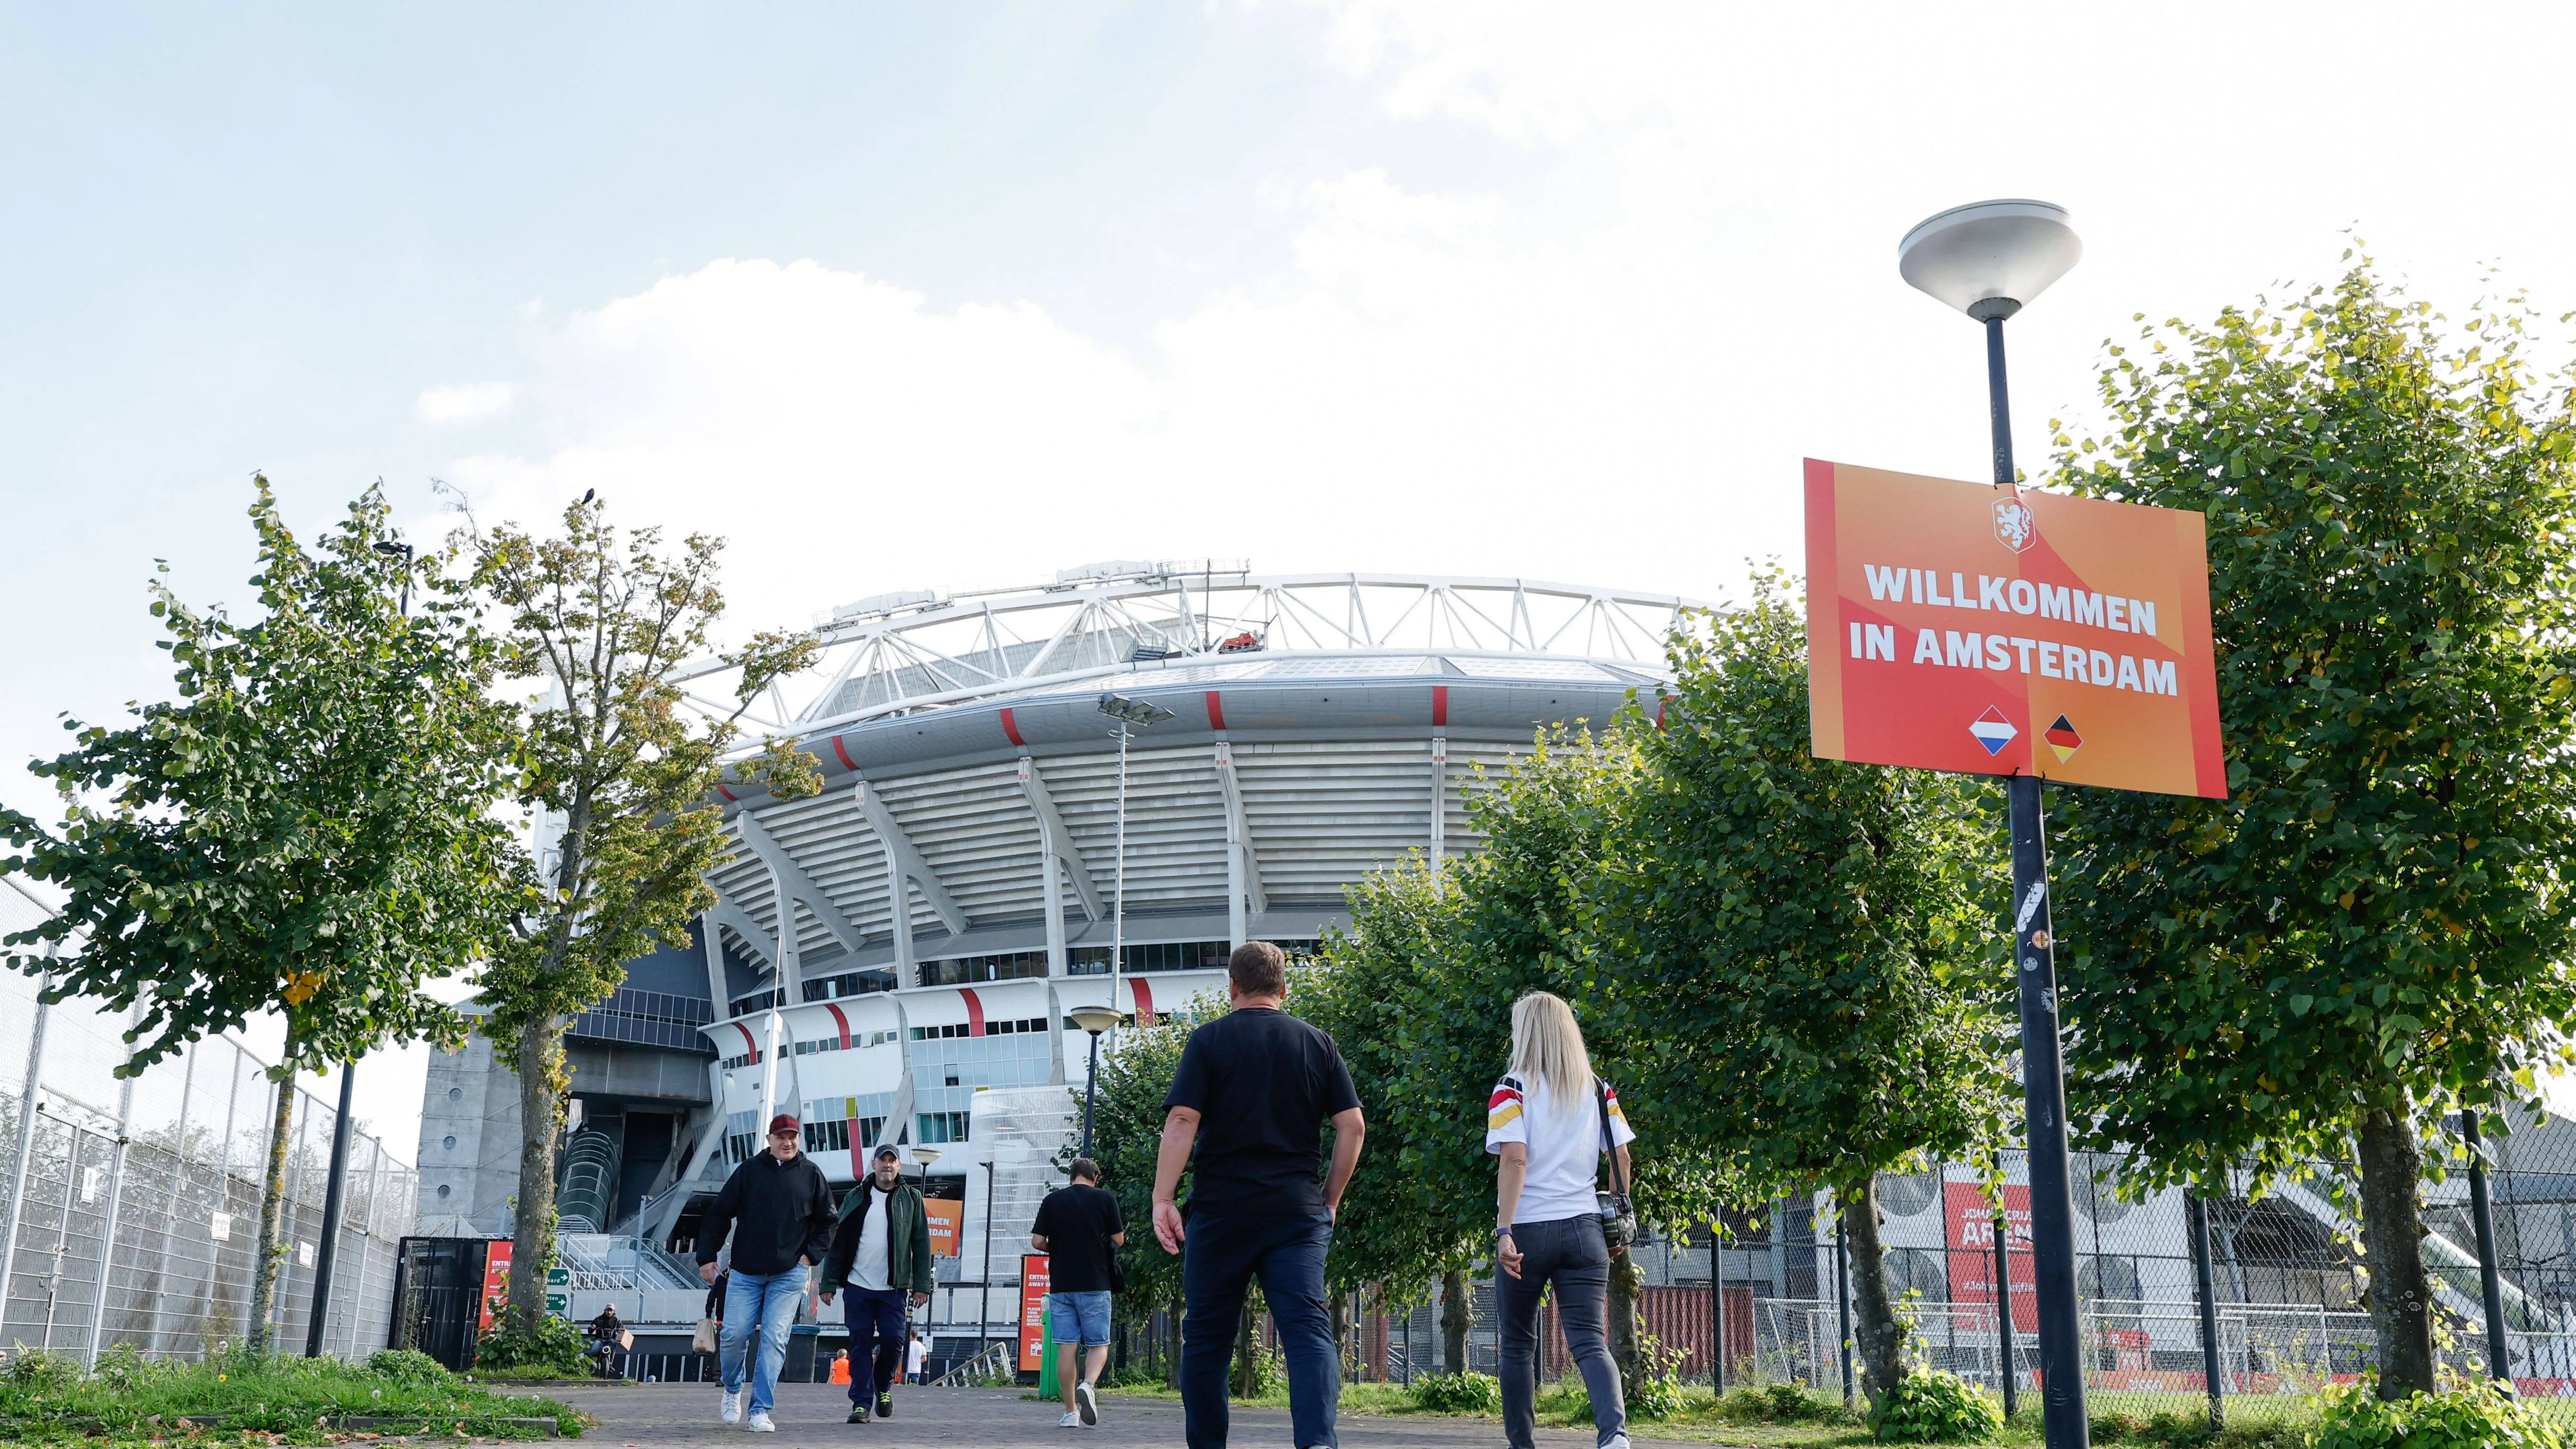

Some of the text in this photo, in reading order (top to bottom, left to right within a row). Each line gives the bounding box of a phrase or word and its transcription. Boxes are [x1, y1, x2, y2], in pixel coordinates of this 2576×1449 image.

[1864, 564, 2156, 637] WILLKOMMEN
[1850, 622, 2178, 696] IN AMSTERDAM
[929, 1228, 952, 1238] RDAM
[1963, 1222, 2034, 1246] AREN
